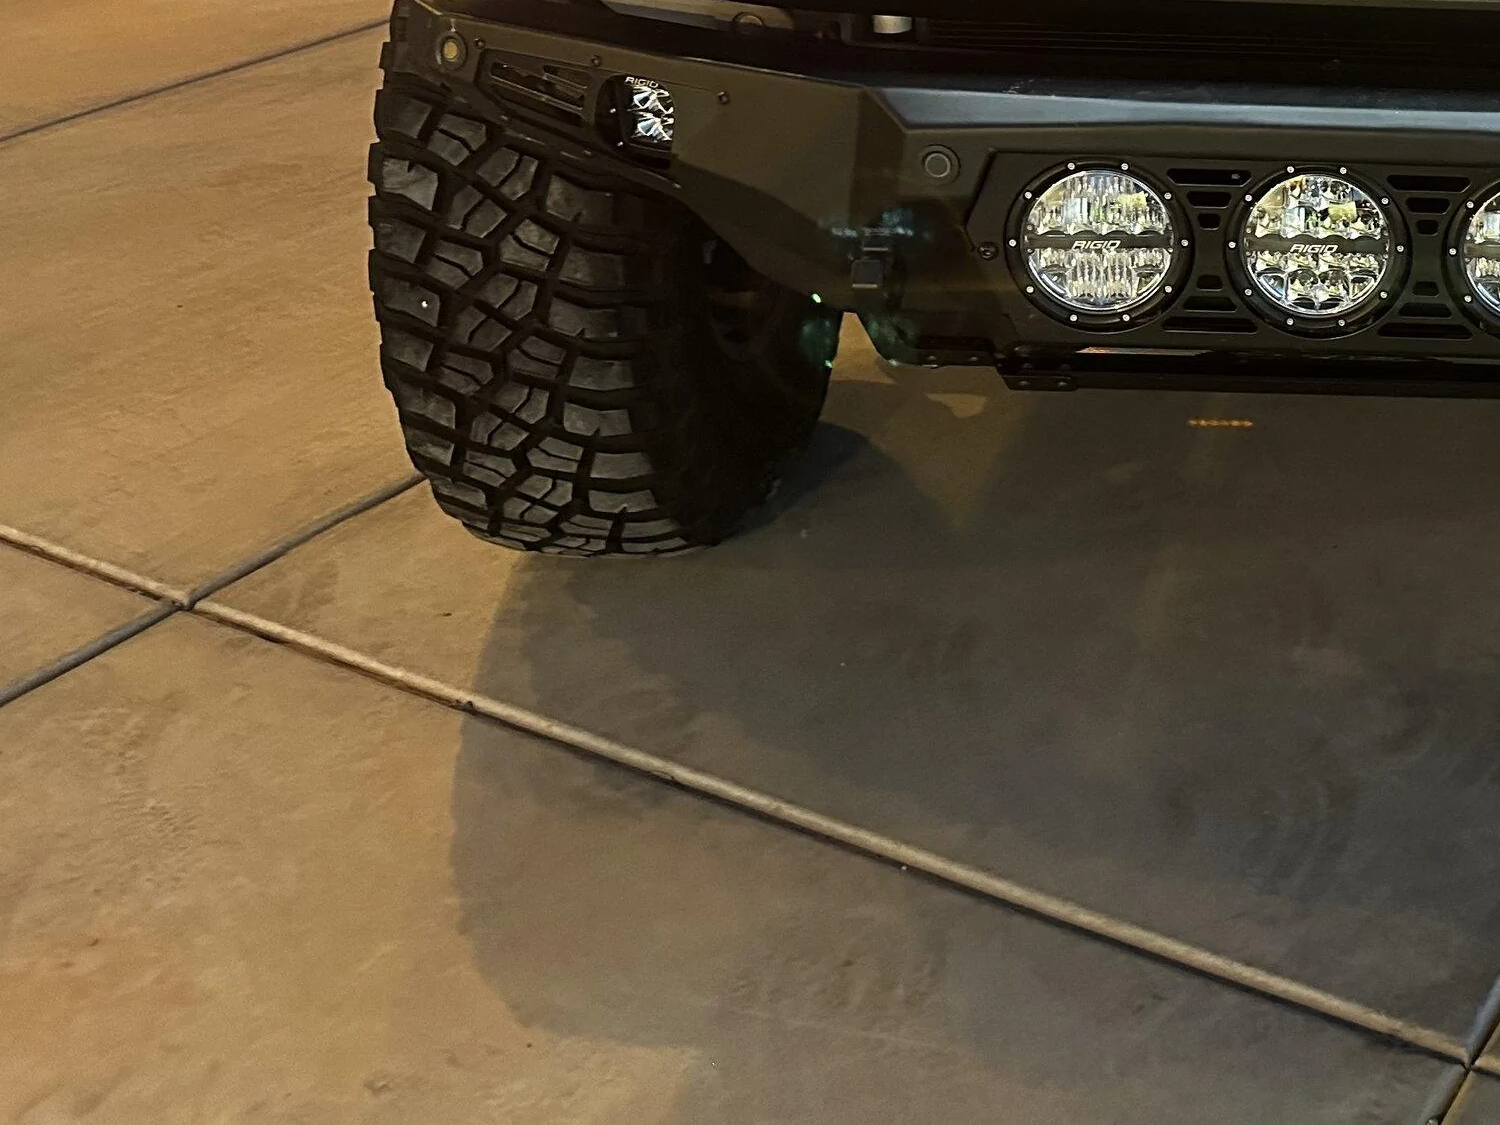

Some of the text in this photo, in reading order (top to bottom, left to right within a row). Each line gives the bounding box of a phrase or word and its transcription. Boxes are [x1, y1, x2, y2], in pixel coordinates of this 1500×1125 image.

[624, 76, 659, 89] RIGID
[1072, 240, 1121, 250] RIGID
[1289, 243, 1339, 254] RIGID
